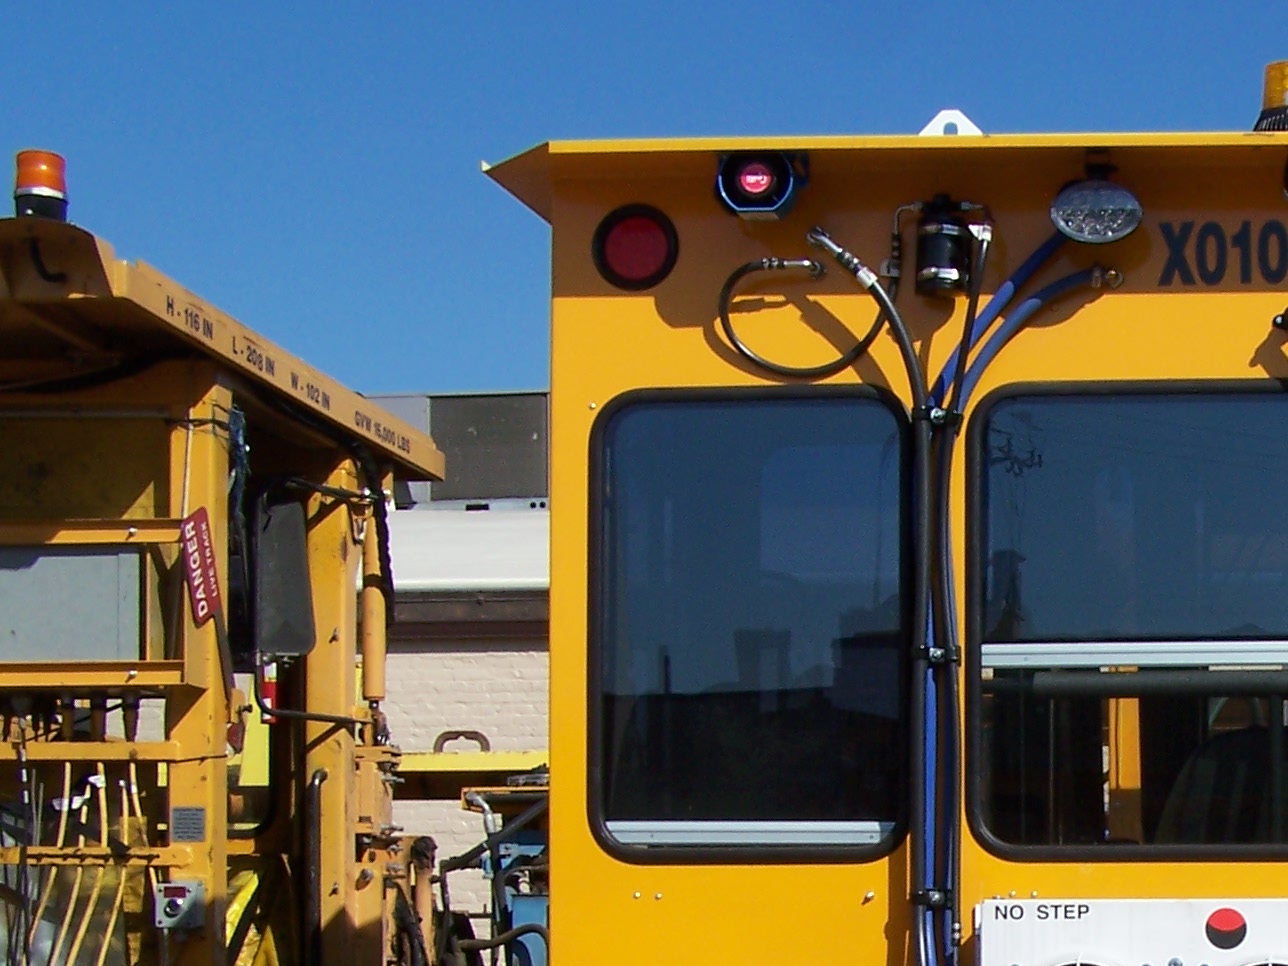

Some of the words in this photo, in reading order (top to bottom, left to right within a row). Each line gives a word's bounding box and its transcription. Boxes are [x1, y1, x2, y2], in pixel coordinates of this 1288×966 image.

[166, 295, 174, 317] H
[184, 308, 200, 331] 116
[202, 318, 214, 340] IN
[232, 336, 239, 355] L
[246, 345, 264, 371] 208
[265, 356, 275, 377] IN
[290, 371, 299, 391] W
[321, 391, 331, 411] IN
[200, 521, 213, 566] TRACK
[185, 521, 208, 618] DANGER
[208, 567, 218, 597] LIVE
[994, 904, 1025, 920] NO
[1036, 904, 1090, 920] STEP
